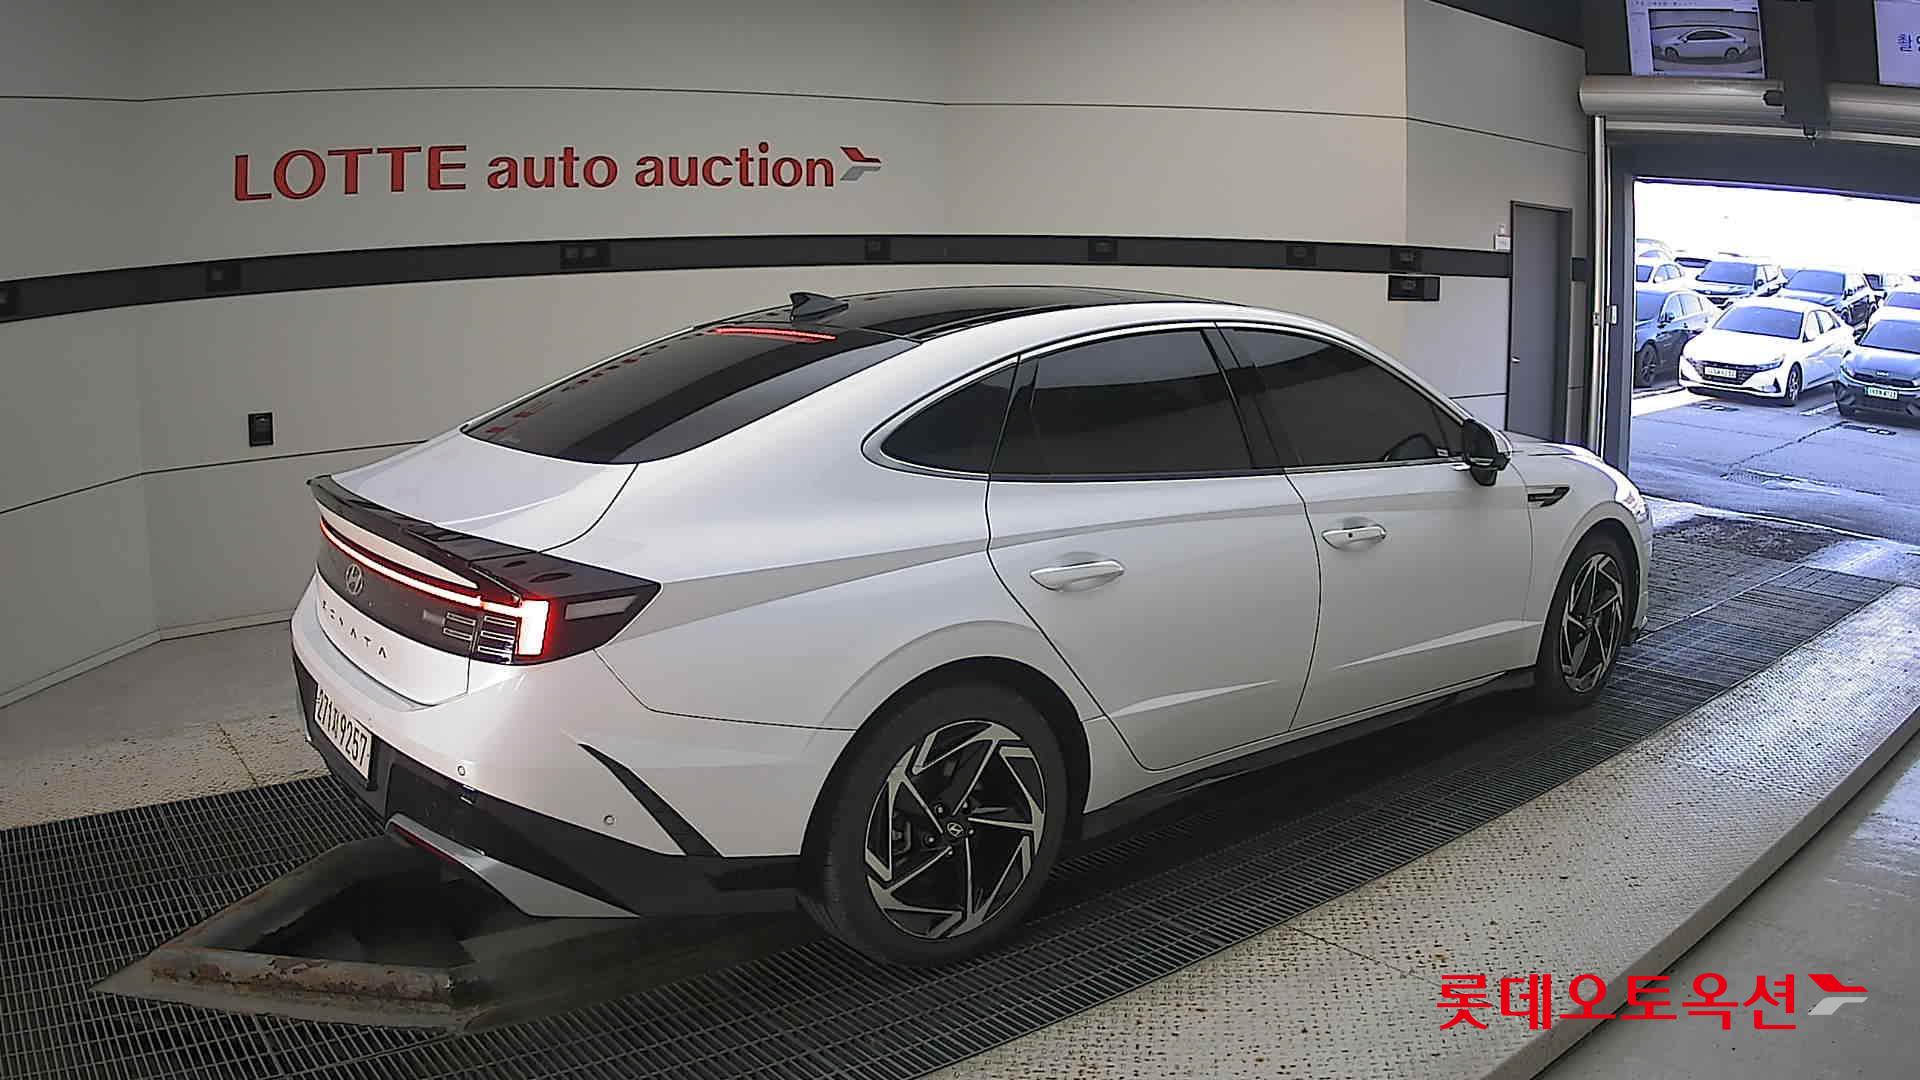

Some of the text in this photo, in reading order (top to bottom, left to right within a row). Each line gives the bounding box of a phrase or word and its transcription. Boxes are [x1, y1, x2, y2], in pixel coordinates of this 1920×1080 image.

[234, 142, 835, 202] LOTTE auto auction
